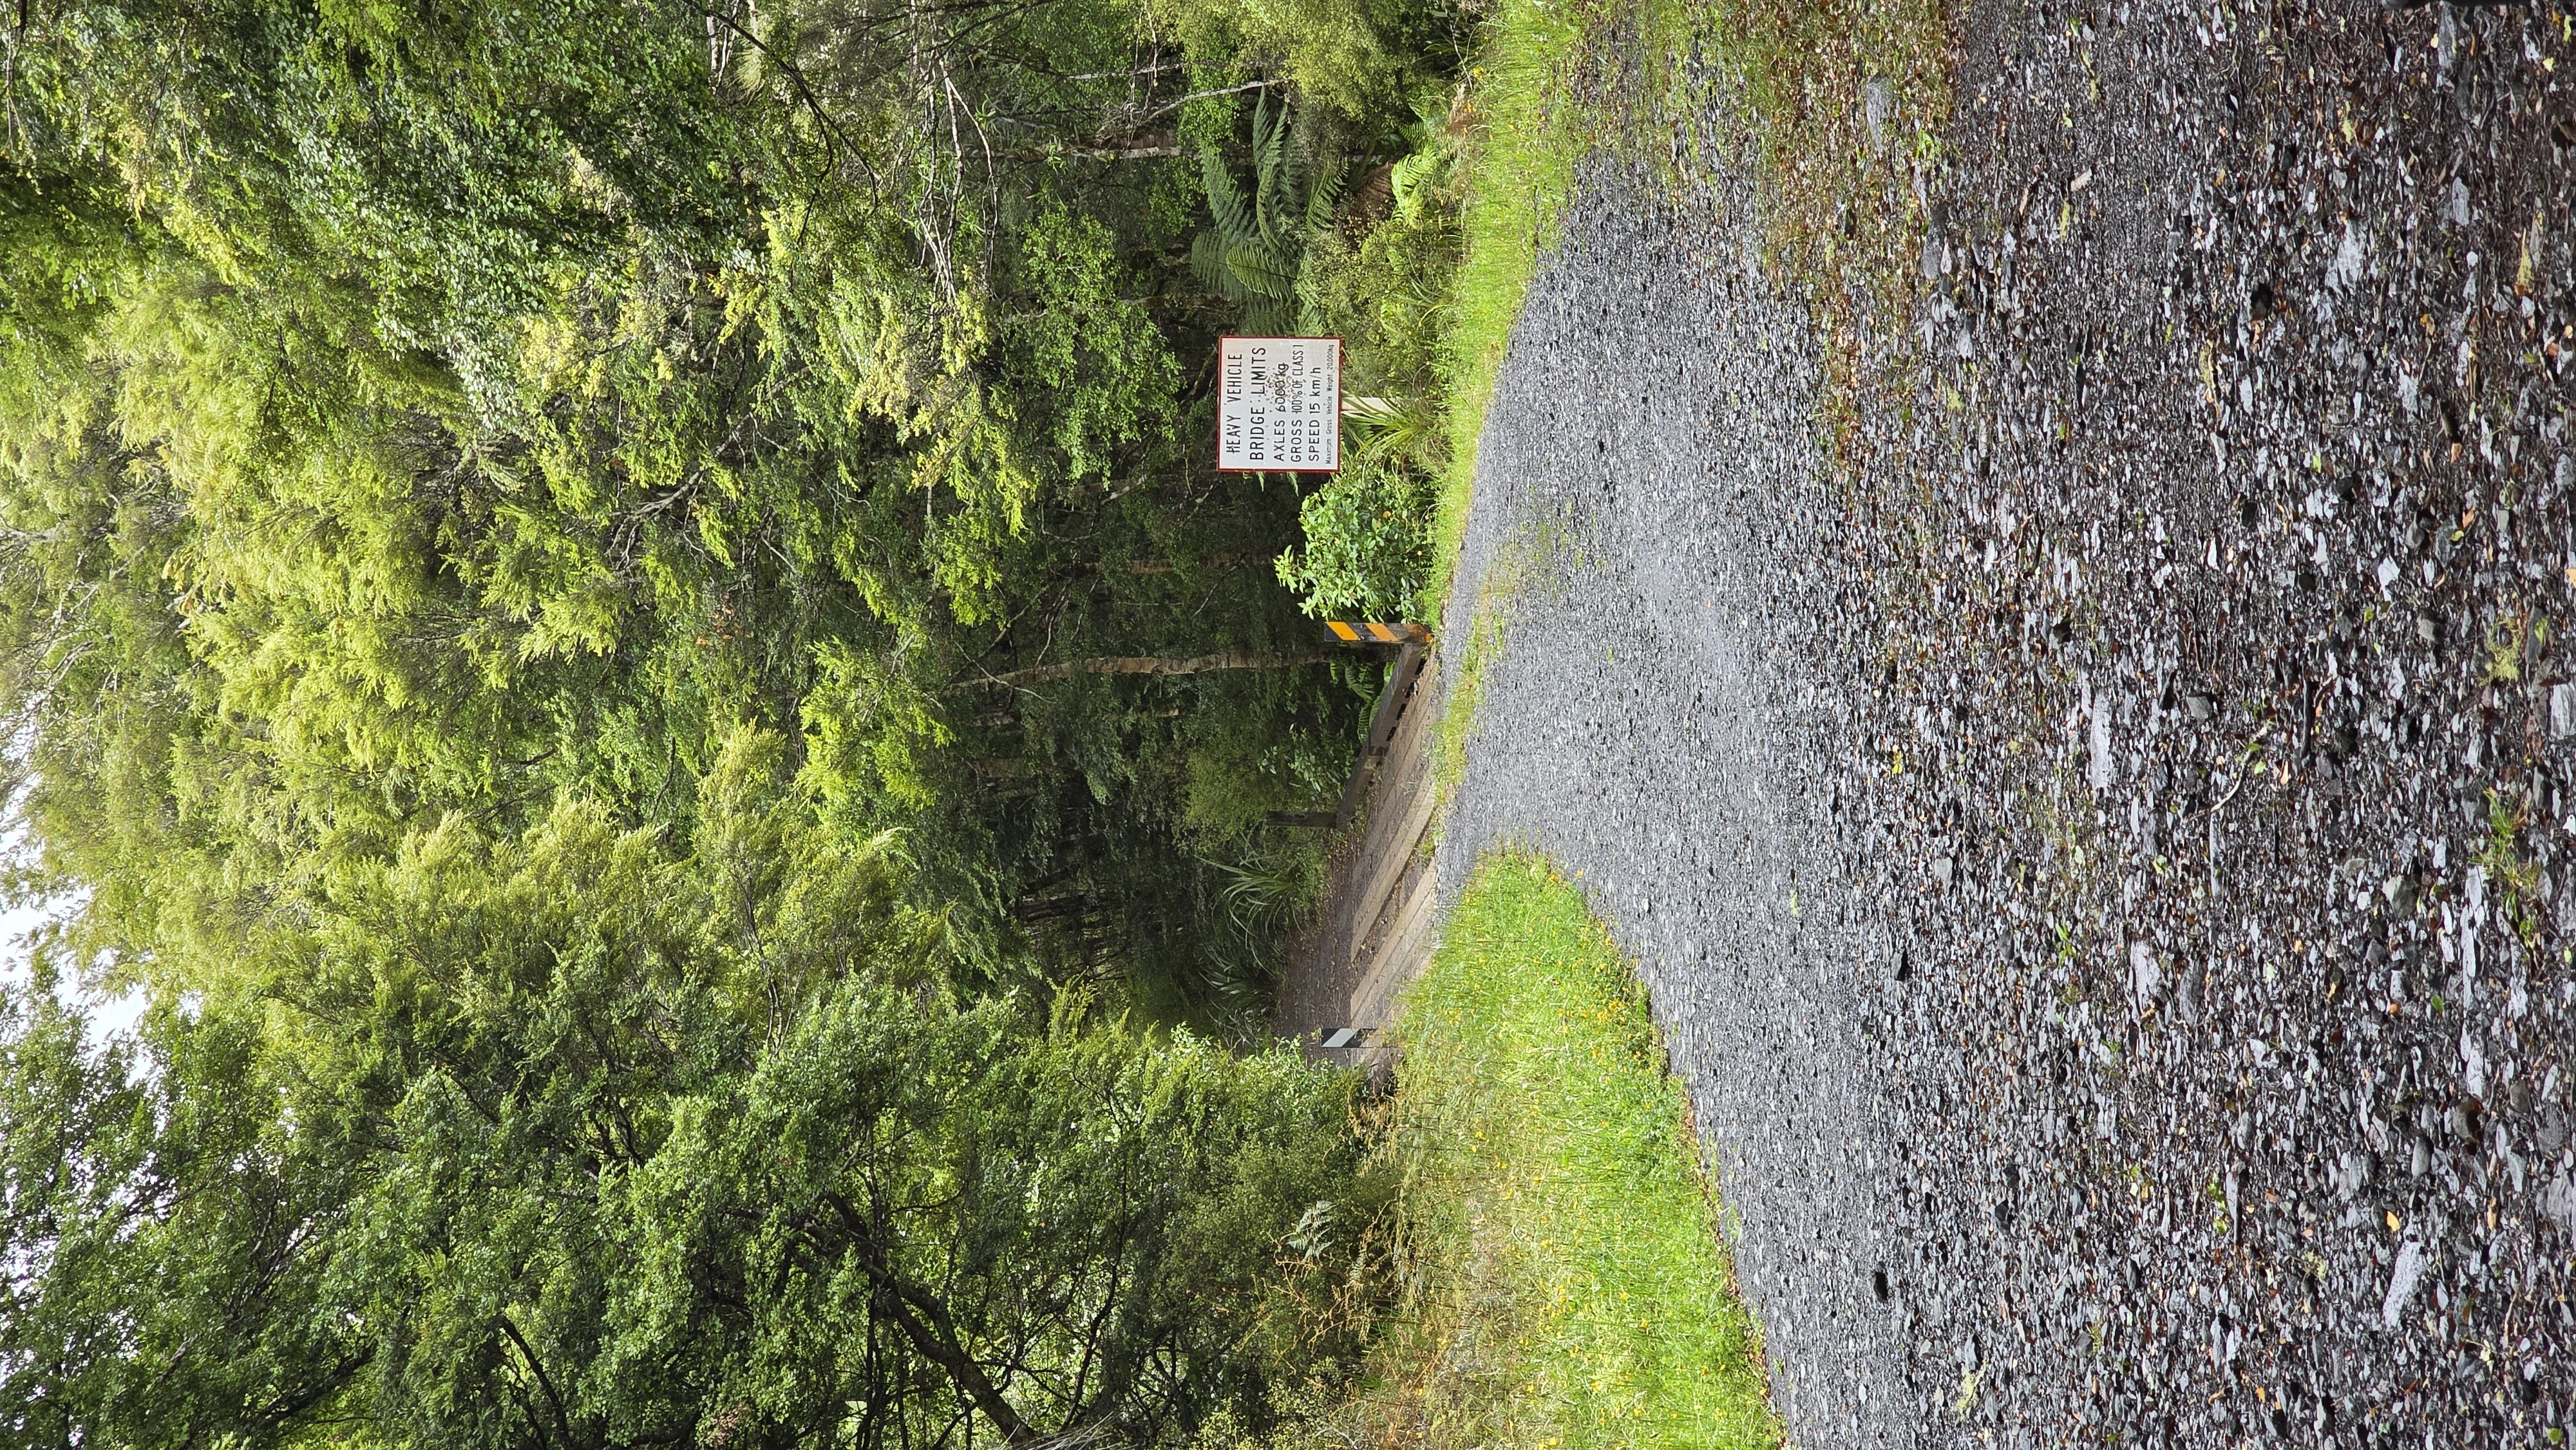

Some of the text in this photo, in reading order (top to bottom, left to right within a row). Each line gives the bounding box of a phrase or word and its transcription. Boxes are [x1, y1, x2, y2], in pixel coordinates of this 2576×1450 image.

[1293, 350, 1303, 375] CLASS
[1293, 379, 1303, 388] OF
[1226, 353, 1242, 454] HEAVY VEHICLE
[1250, 347, 1266, 460] BRIDGE LIMITS
[1274, 363, 1289, 462] AXLES 6000 kg
[1292, 391, 1303, 413] 100%
[1309, 367, 1321, 462] SPEED 15 km/h
[1291, 419, 1302, 462] GROSS
